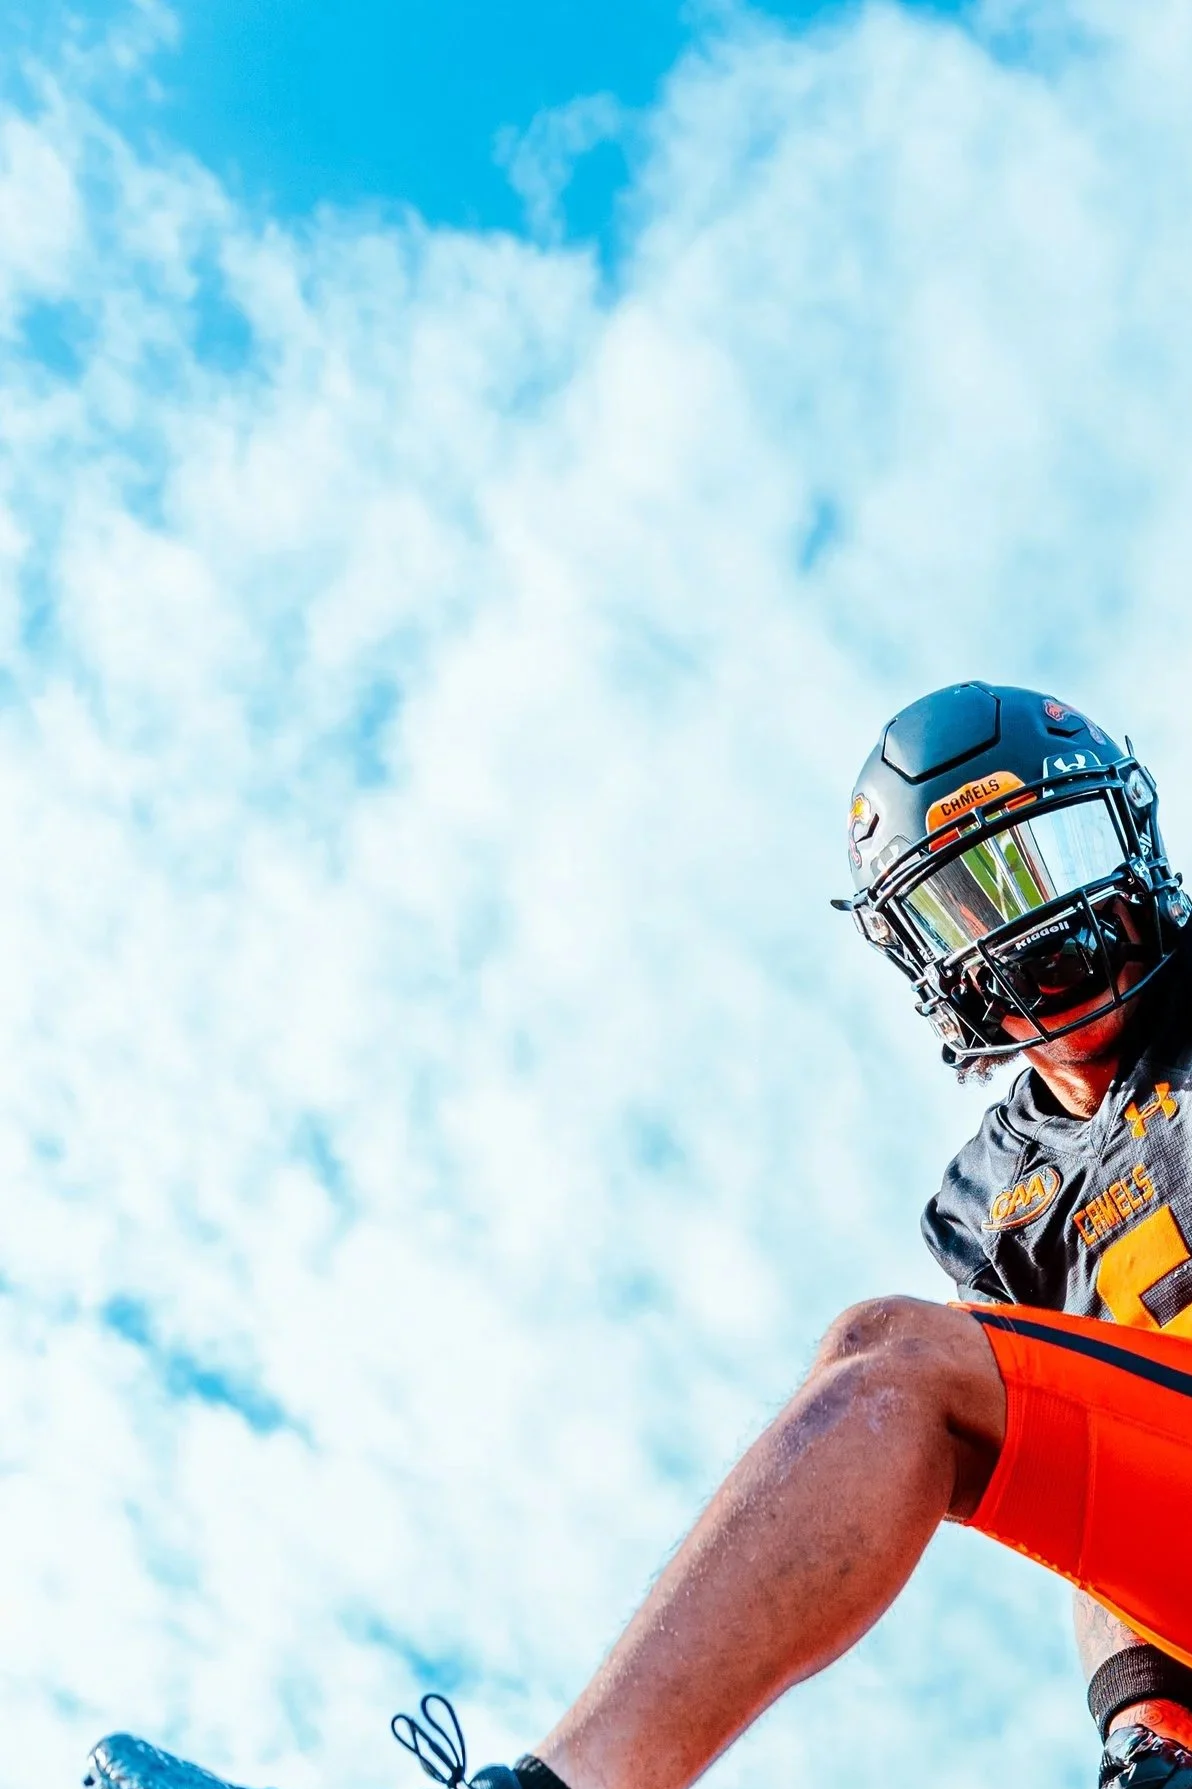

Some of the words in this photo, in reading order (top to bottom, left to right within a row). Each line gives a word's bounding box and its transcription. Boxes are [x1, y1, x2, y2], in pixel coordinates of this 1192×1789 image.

[940, 779, 1000, 816] CAMELS
[990, 1173, 1047, 1221] CAA
[1073, 1163, 1156, 1247] CAMELS
